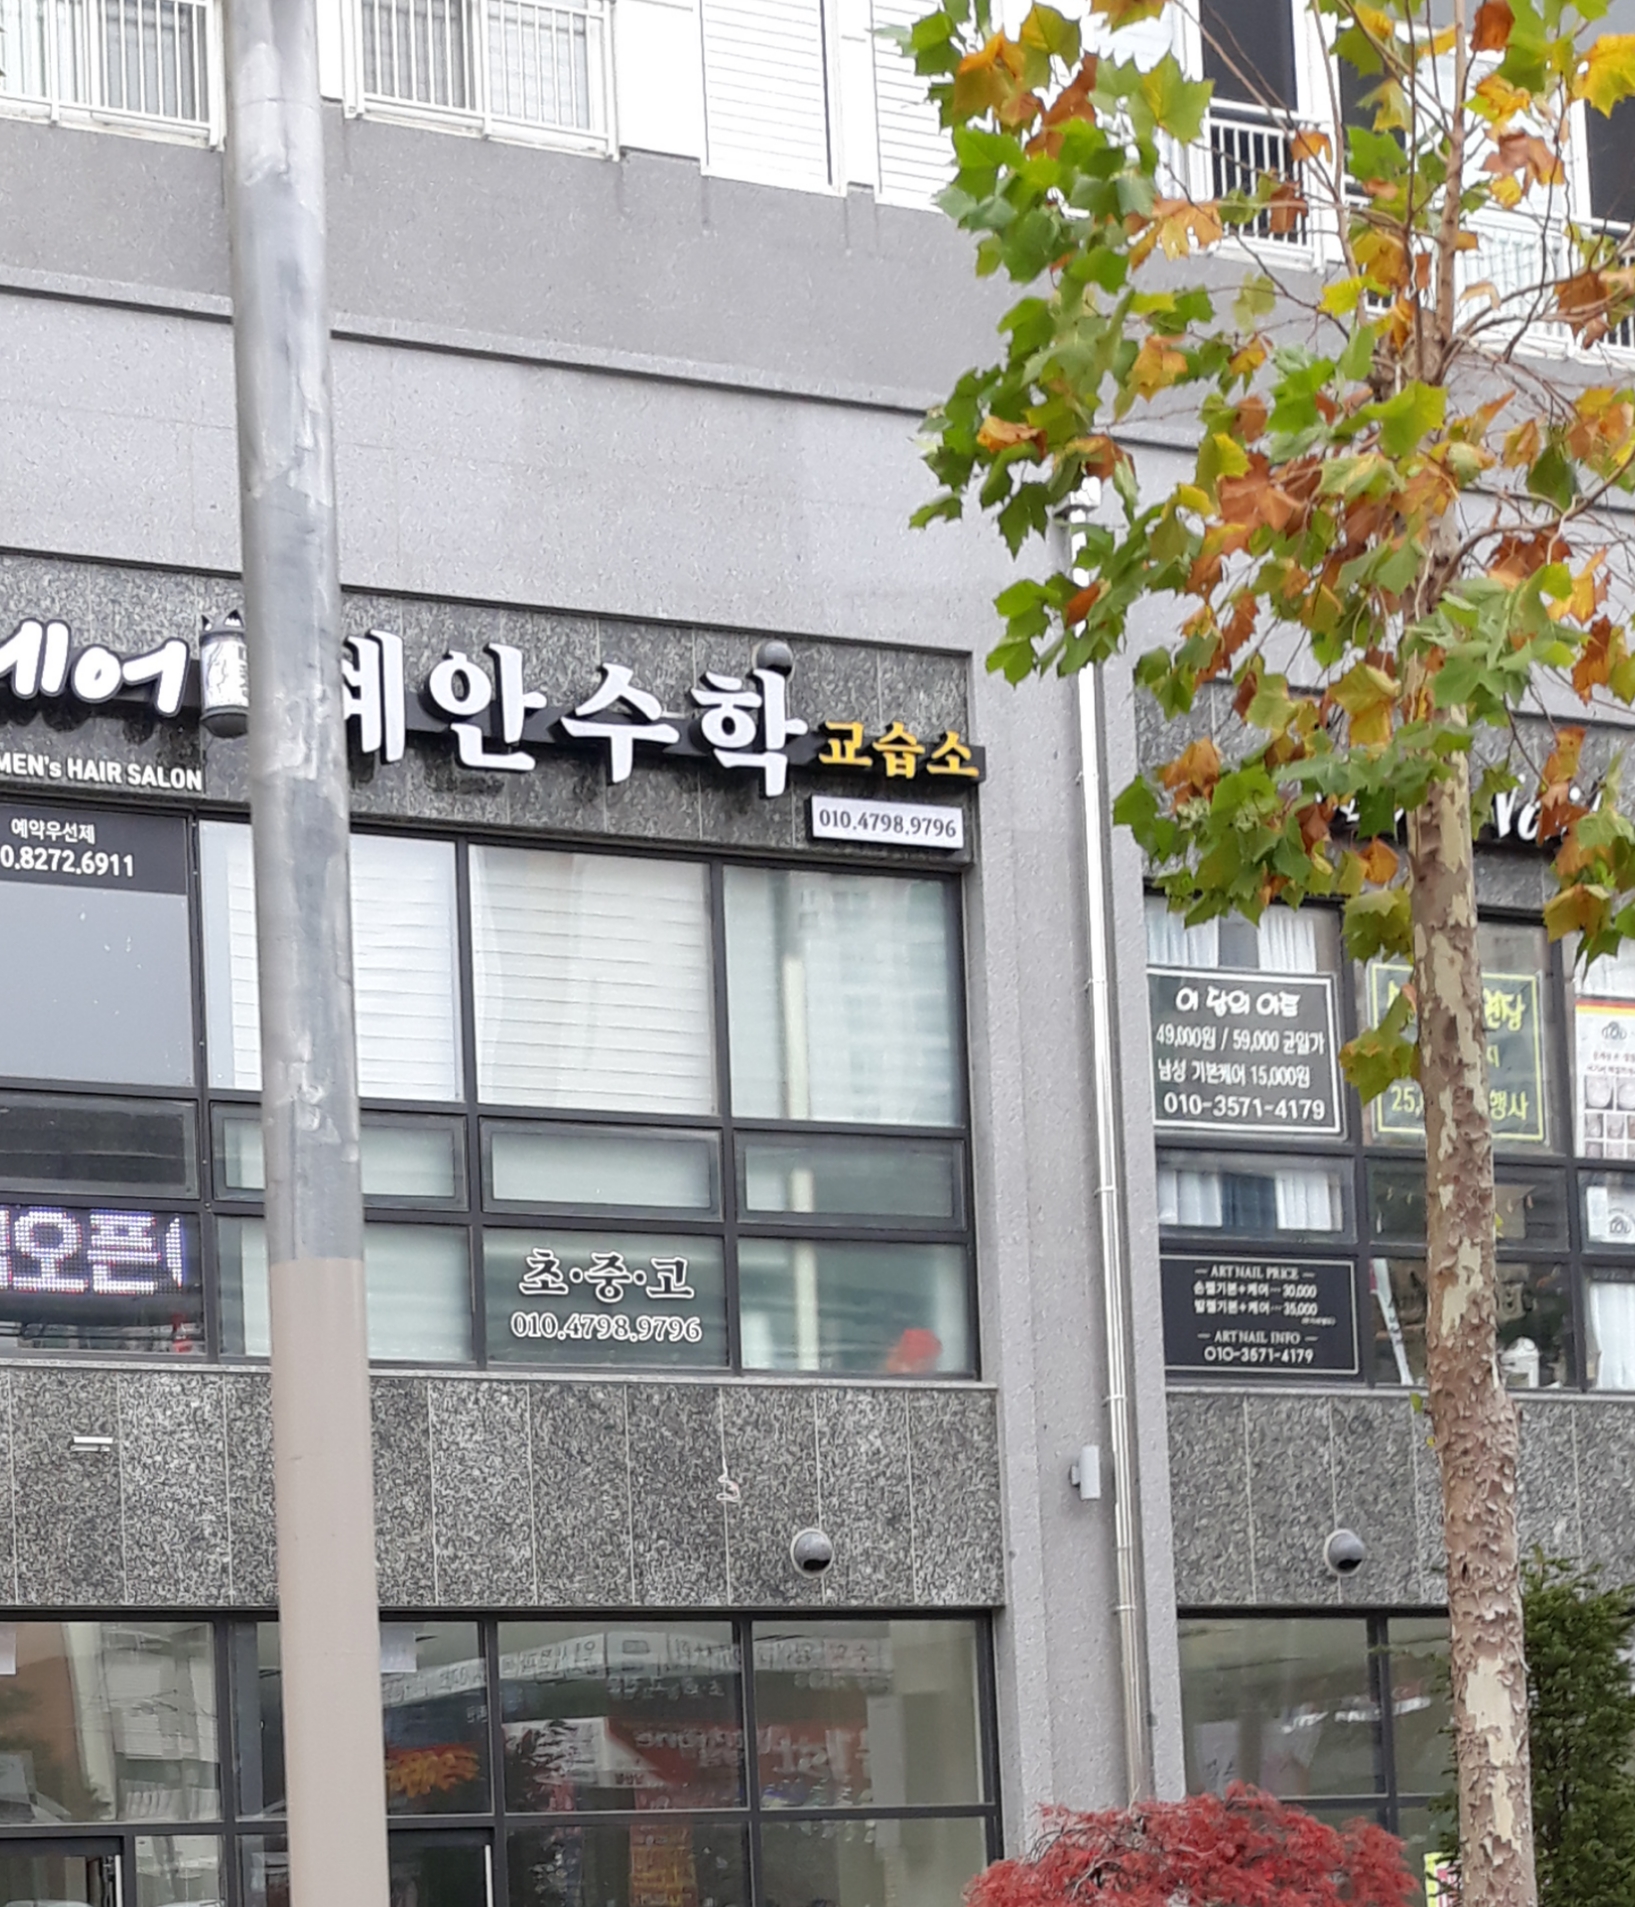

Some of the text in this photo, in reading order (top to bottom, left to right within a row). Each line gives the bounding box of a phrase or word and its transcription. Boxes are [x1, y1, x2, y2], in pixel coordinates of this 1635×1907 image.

[818, 720, 980, 779] 교습소
[67, 757, 122, 784] HAIR
[127, 764, 202, 791] SALON
[10, 817, 96, 845] 예약우선제
[819, 808, 957, 838] 010.4798.9796
[1232, 1028, 1280, 1052] 59,000
[1282, 1030, 1326, 1056] 균일가
[1157, 1057, 1311, 1089] 남성 기본케어 15,000원
[1163, 1091, 1326, 1121] 010-3571-4179
[511, 1311, 702, 1343] 010.4798.9796
[1203, 1346, 1315, 1364] 010-3571-4179
